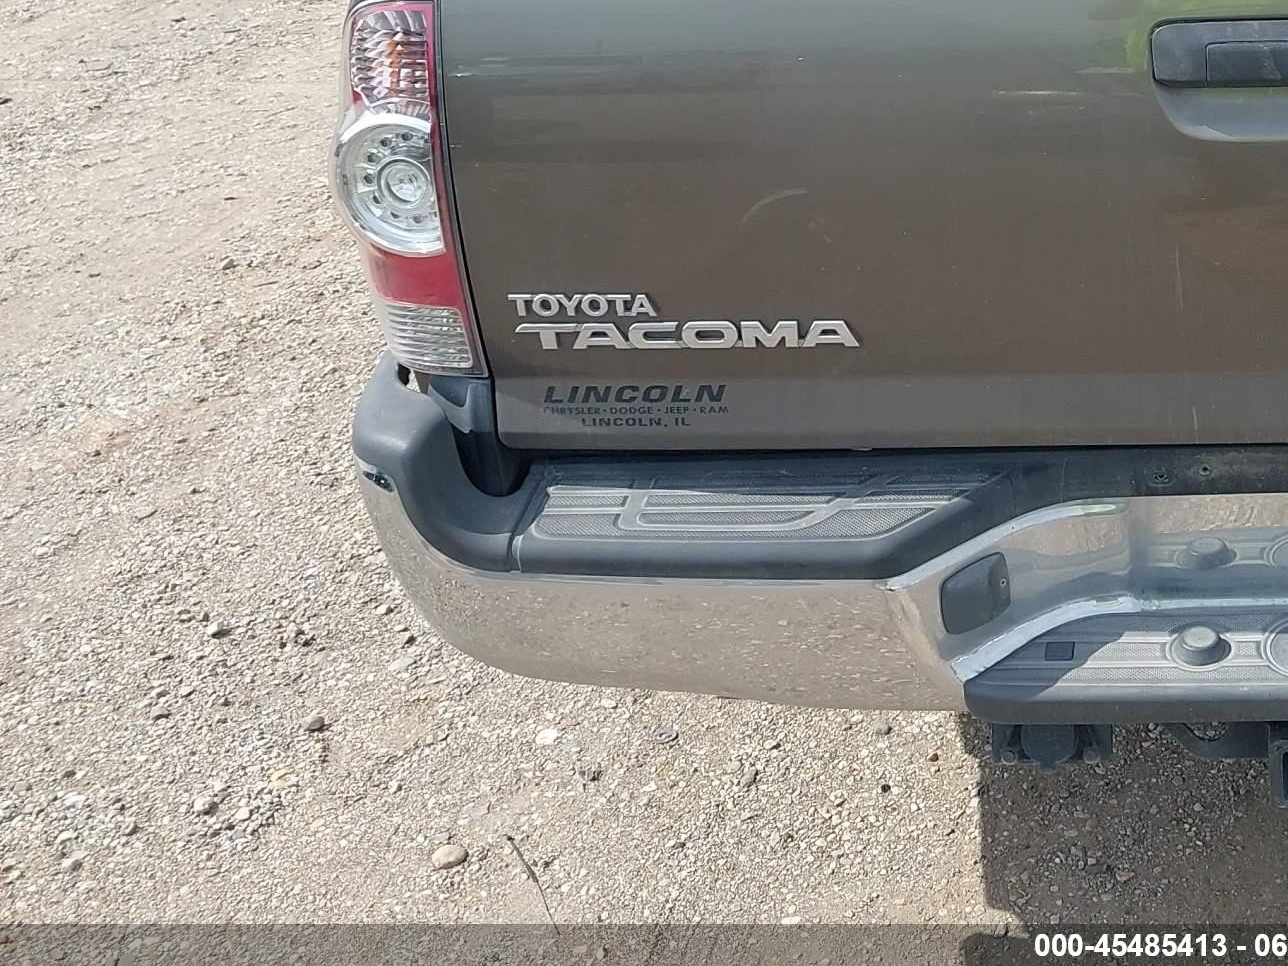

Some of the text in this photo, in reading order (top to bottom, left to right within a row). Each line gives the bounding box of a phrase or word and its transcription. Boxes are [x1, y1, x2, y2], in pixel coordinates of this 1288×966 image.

[507, 293, 657, 317] TOYOTA
[515, 319, 860, 350] TACOMA
[543, 384, 727, 404] LINCOLN
[609, 406, 654, 415] DODGE
[664, 406, 690, 415] JEEP
[700, 405, 729, 415] RAM
[674, 416, 691, 427] IL
